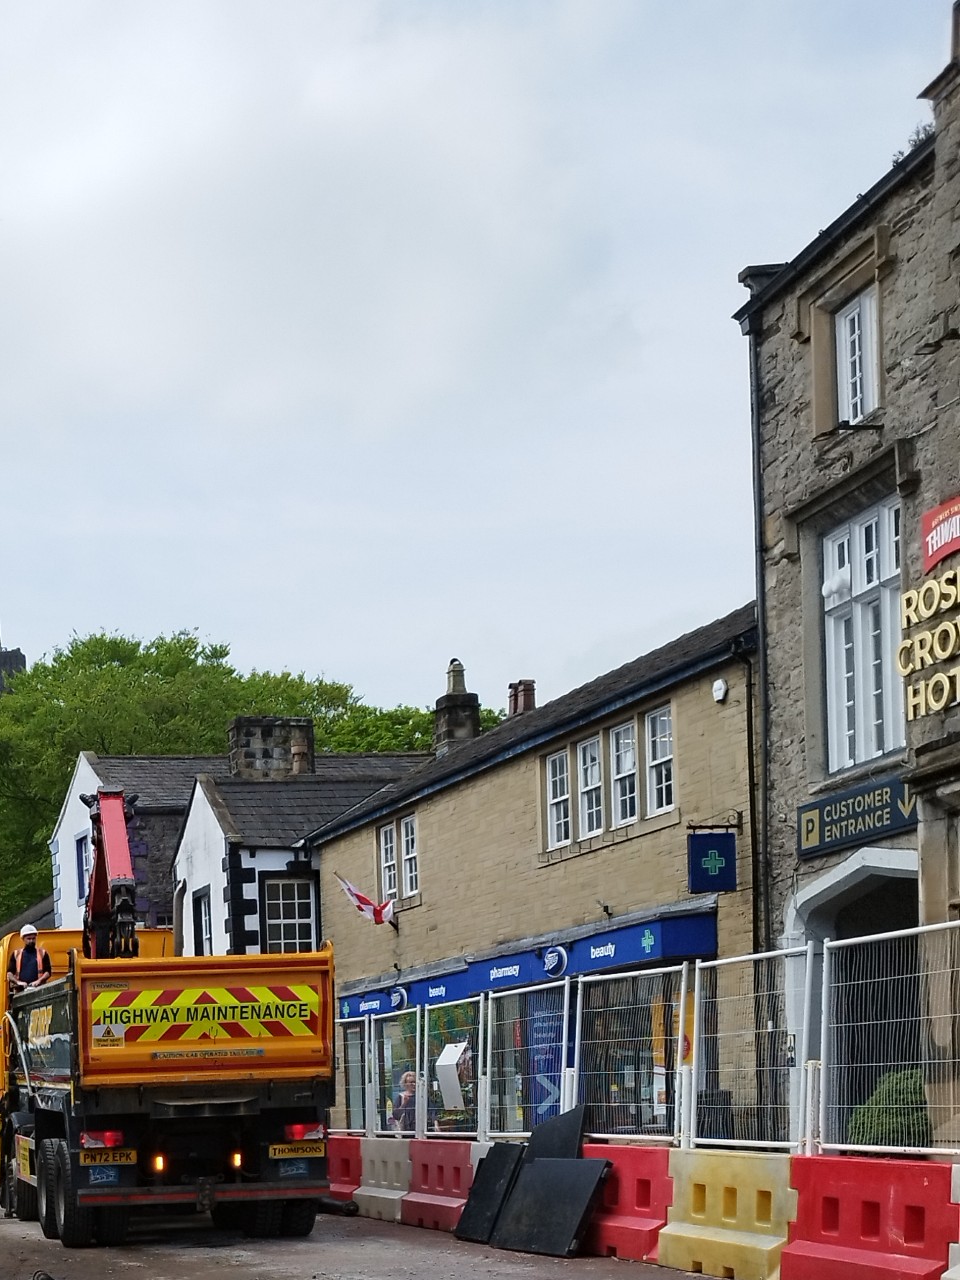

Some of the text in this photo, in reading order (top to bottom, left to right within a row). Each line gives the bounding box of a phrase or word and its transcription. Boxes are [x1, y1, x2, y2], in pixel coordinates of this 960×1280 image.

[896, 615, 960, 677] CRO
[824, 787, 891, 822] CUSTOMER
[806, 818, 815, 841] P
[824, 808, 891, 842] ENTRANCE
[490, 964, 520, 981] pharmacy
[590, 943, 615, 959] beauty
[359, 1000, 380, 1012] pharmacy
[428, 985, 446, 998] beauty
[102, 1003, 309, 1025] HIGHWAY MAINTENANCE
[84, 1152, 132, 1163] PN72 EPK
[273, 1146, 322, 1156] THOMPSONS
